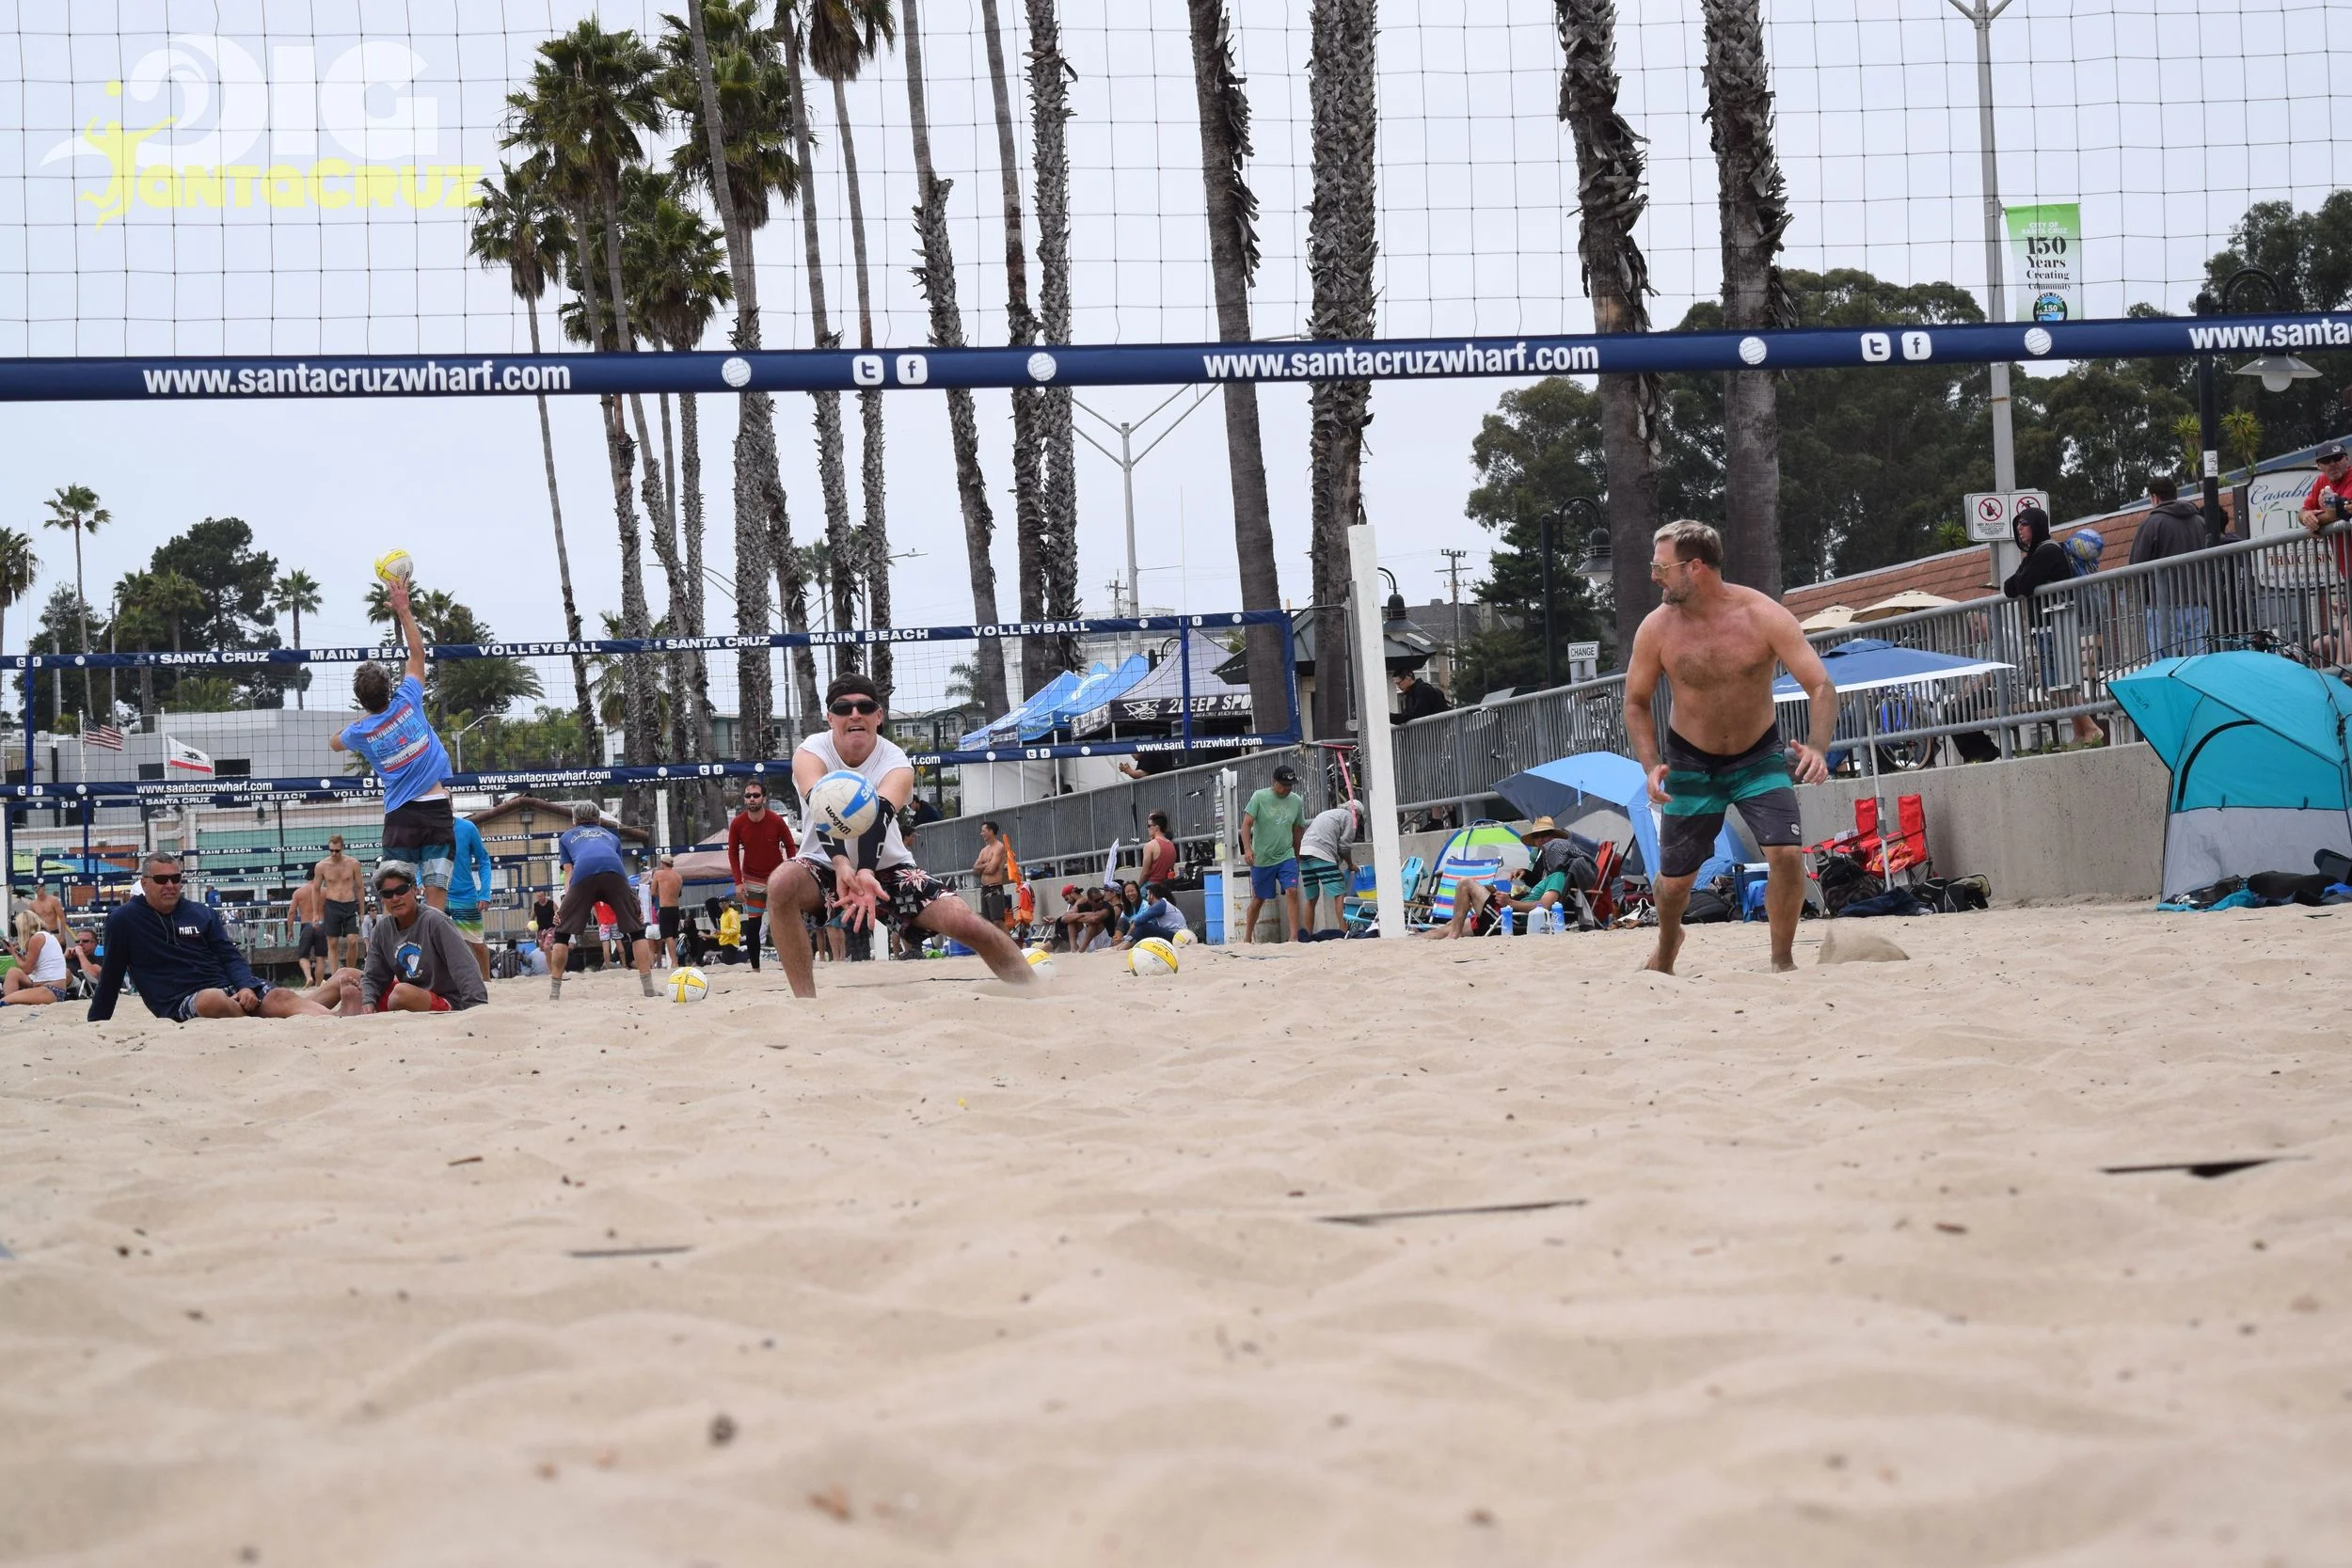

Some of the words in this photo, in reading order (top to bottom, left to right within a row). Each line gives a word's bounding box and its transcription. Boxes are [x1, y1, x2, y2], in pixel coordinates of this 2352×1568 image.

[2026, 236, 2067, 255] 150
[2026, 255, 2066, 268] Years
[2026, 270, 2070, 280] Creating
[2028, 282, 2072, 293] Community
[2189, 318, 2352, 350] www.santa
[1203, 341, 1599, 378] www.santacruzwharf.com
[143, 360, 571, 396] www.santacruzwharf.com
[2250, 475, 2314, 505] Casabl
[810, 631, 857, 644] MAIN
[865, 628, 929, 641] BEACH
[972, 622, 1090, 637] VOLLEYBALL
[478, 641, 602, 657] VOLLEYBALL
[666, 638, 720, 650] SANTA
[724, 636, 771, 647] CRUZ
[160, 652, 217, 664] SANTA
[221, 651, 270, 663] CRUZ
[310, 649, 359, 660] MAIN
[367, 647, 435, 659] BEAH
[1570, 646, 1595, 657] CHANGE
[1221, 694, 1253, 710] SPO
[1136, 736, 1263, 752] www.santcruzwharf.com
[479, 769, 612, 784] www.santacruzwharf.com
[136, 782, 273, 794] www.santacruzwharf.com
[333, 789, 385, 798] VOLLEYB
[825, 805, 851, 835] Wilson
